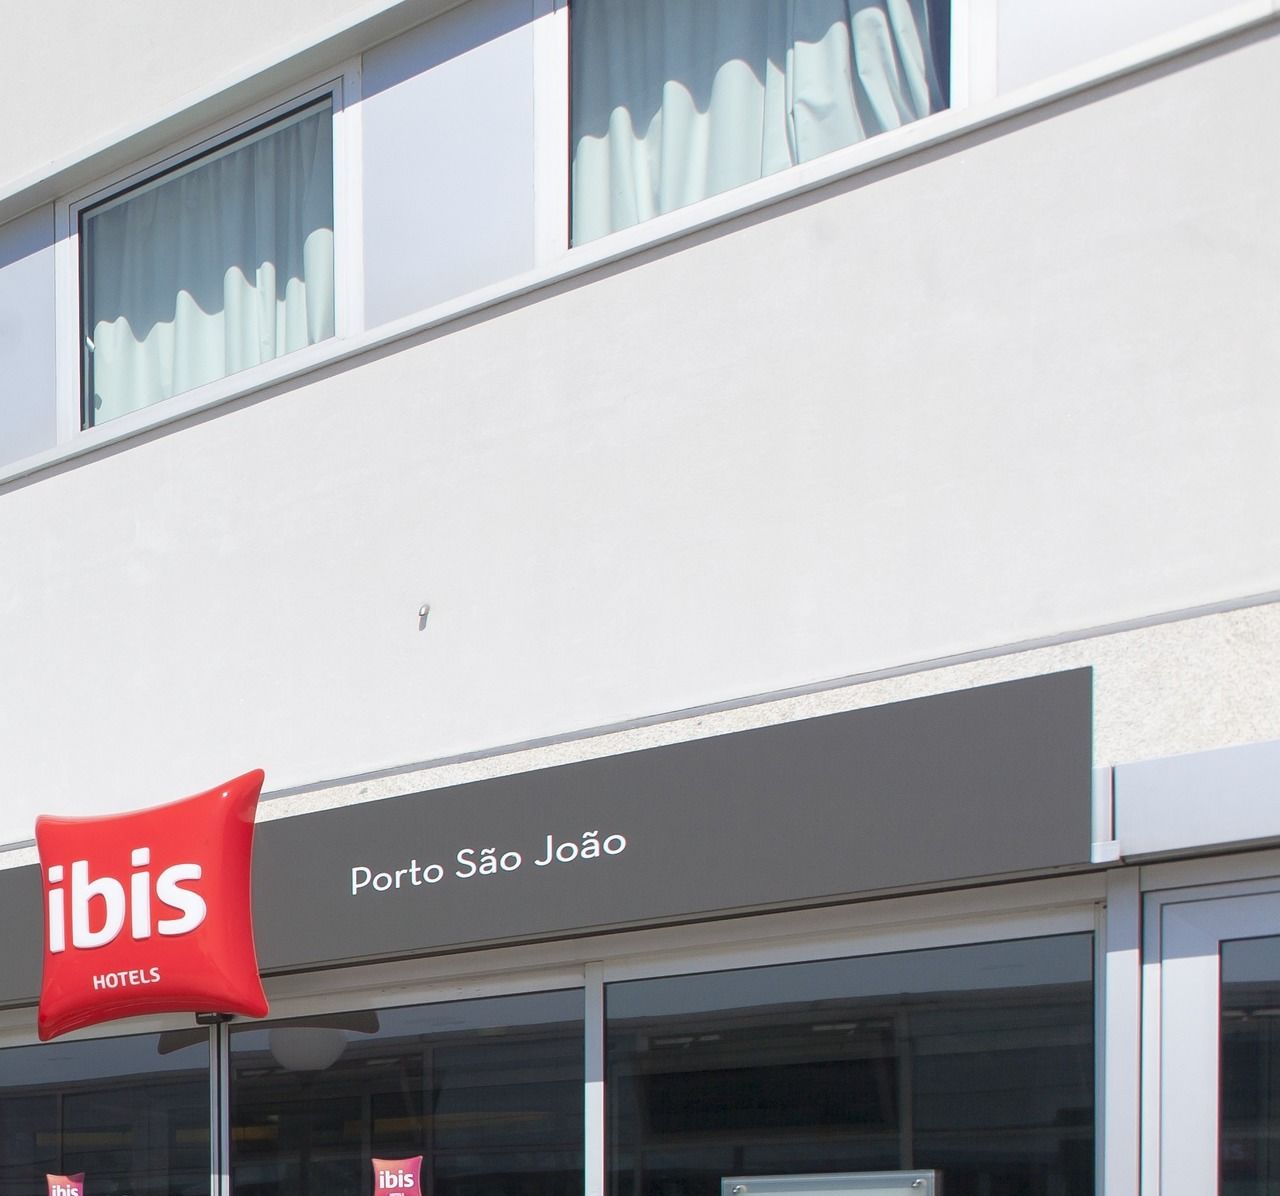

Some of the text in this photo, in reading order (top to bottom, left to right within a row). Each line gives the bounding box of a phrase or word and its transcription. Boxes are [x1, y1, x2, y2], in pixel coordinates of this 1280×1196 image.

[350, 830, 627, 896] Porto São João
[47, 847, 207, 953] ibis
[92, 967, 161, 990] HOTELS
[379, 1170, 414, 1188] ibis
